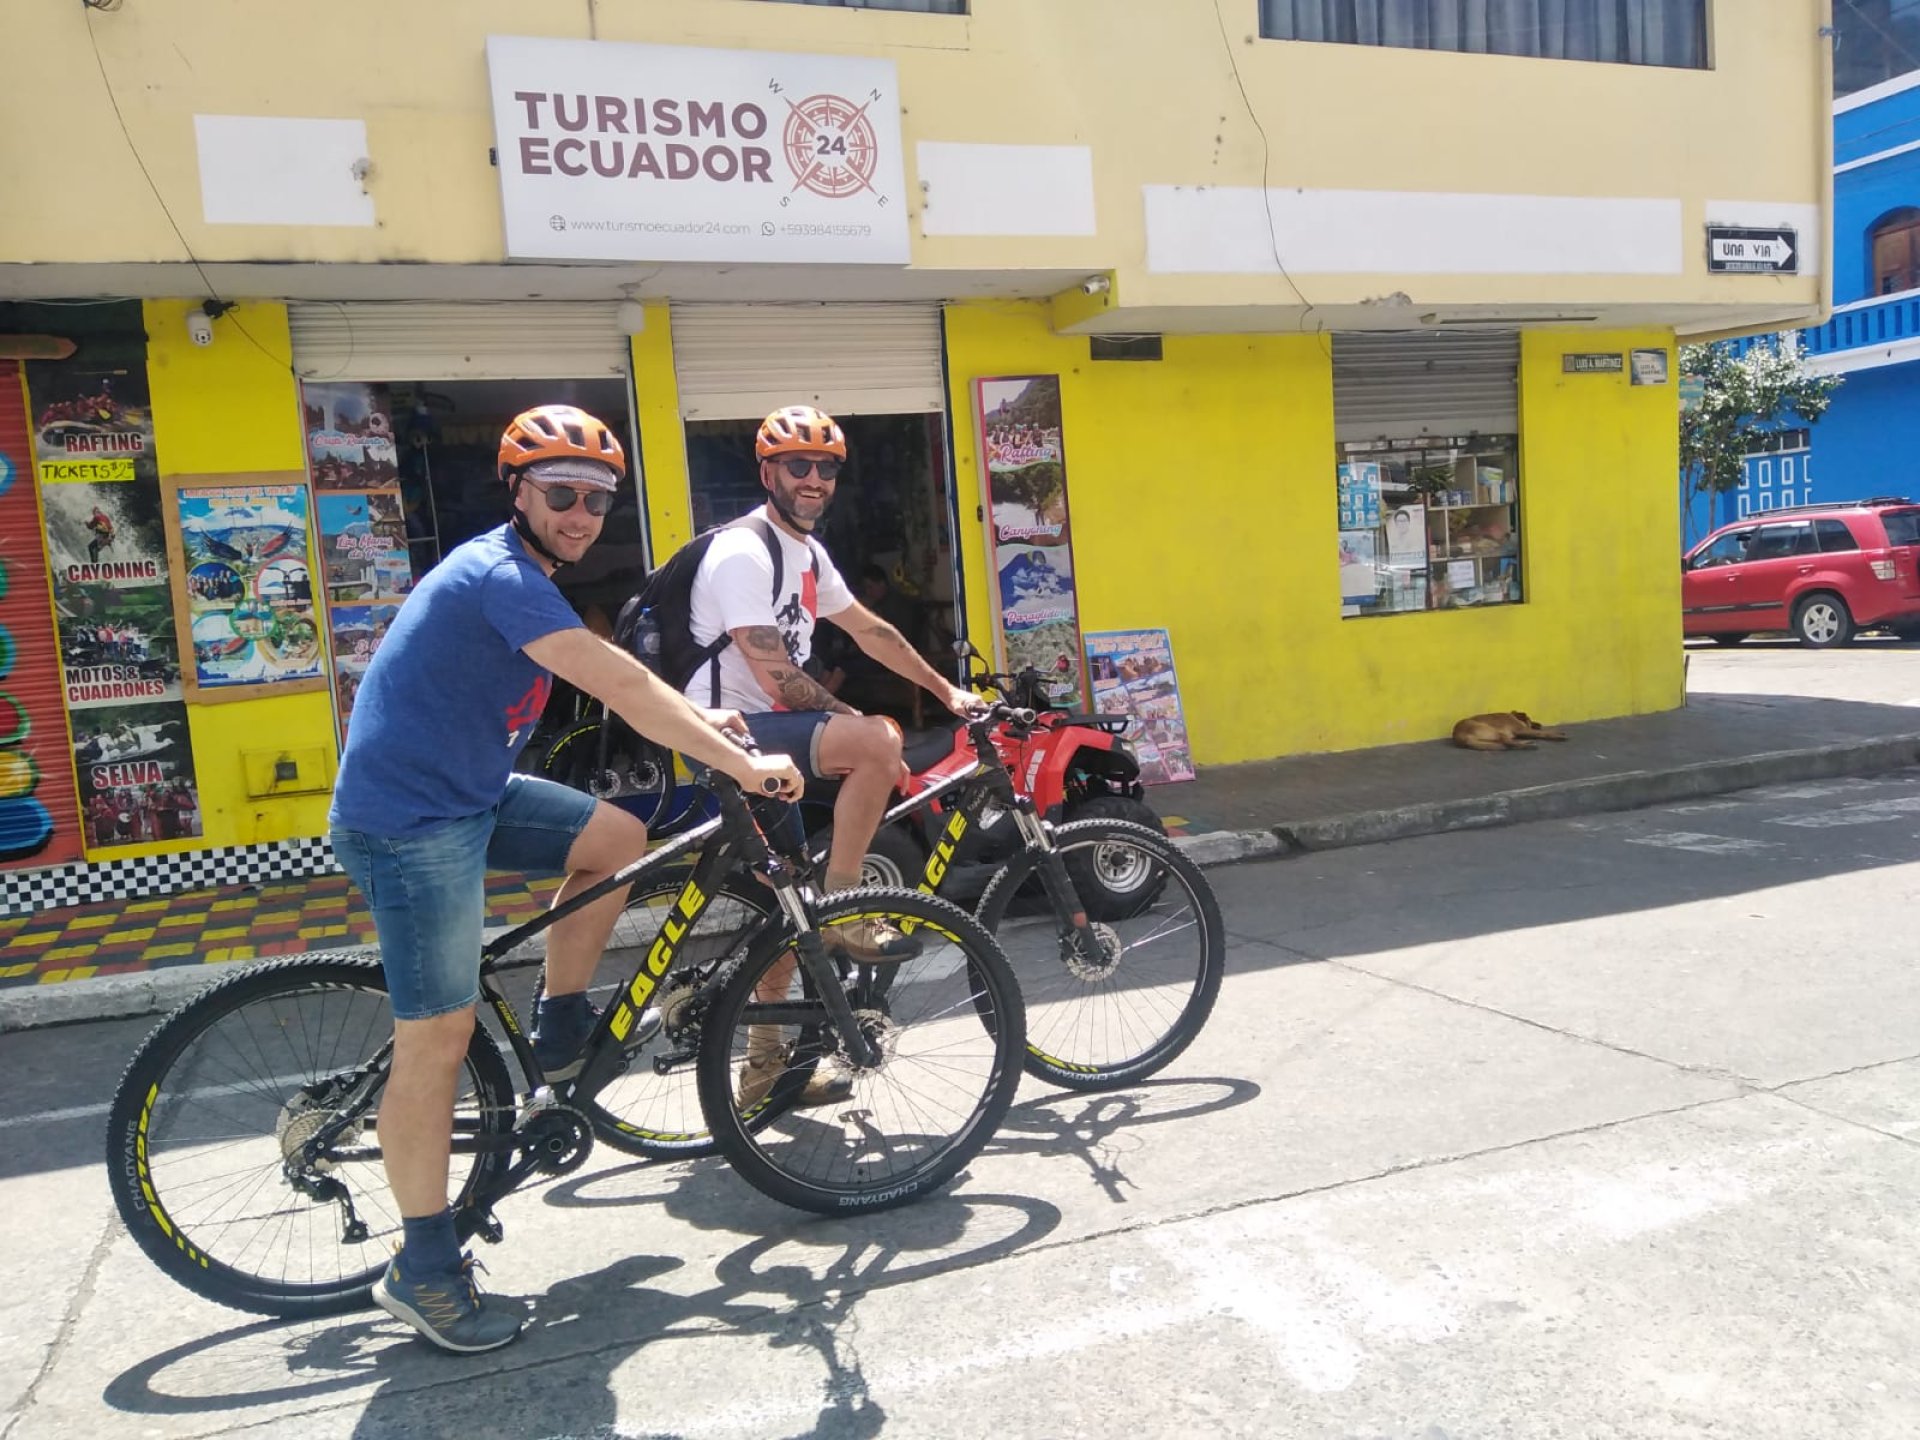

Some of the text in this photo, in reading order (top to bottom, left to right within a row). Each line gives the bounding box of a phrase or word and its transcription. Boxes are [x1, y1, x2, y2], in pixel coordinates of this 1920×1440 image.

[768, 78, 784, 94] W
[870, 87, 882, 101] N
[514, 91, 768, 140] TURISMO
[816, 135, 847, 155] 24
[519, 137, 774, 183] ECUADOR
[779, 196, 791, 208] S
[877, 195, 889, 208] E
[570, 219, 751, 236] www.turismoecuador24.com
[779, 224, 871, 237] +593984155679
[1722, 242, 1771, 258] UNA VIA
[66, 432, 144, 453] RAFTING
[1000, 442, 1053, 463] Rafting
[41, 463, 111, 480] TICKETS
[999, 524, 1063, 542] Canyoning
[67, 560, 157, 583] CAYONING
[66, 665, 139, 685] MOTOS &
[68, 679, 164, 702] CUADRONES
[93, 760, 164, 789] SELVA
[609, 879, 706, 1042] EAGLE
[124, 1120, 146, 1212] CHAOYANG
[838, 1181, 918, 1207] CHAOYANG
